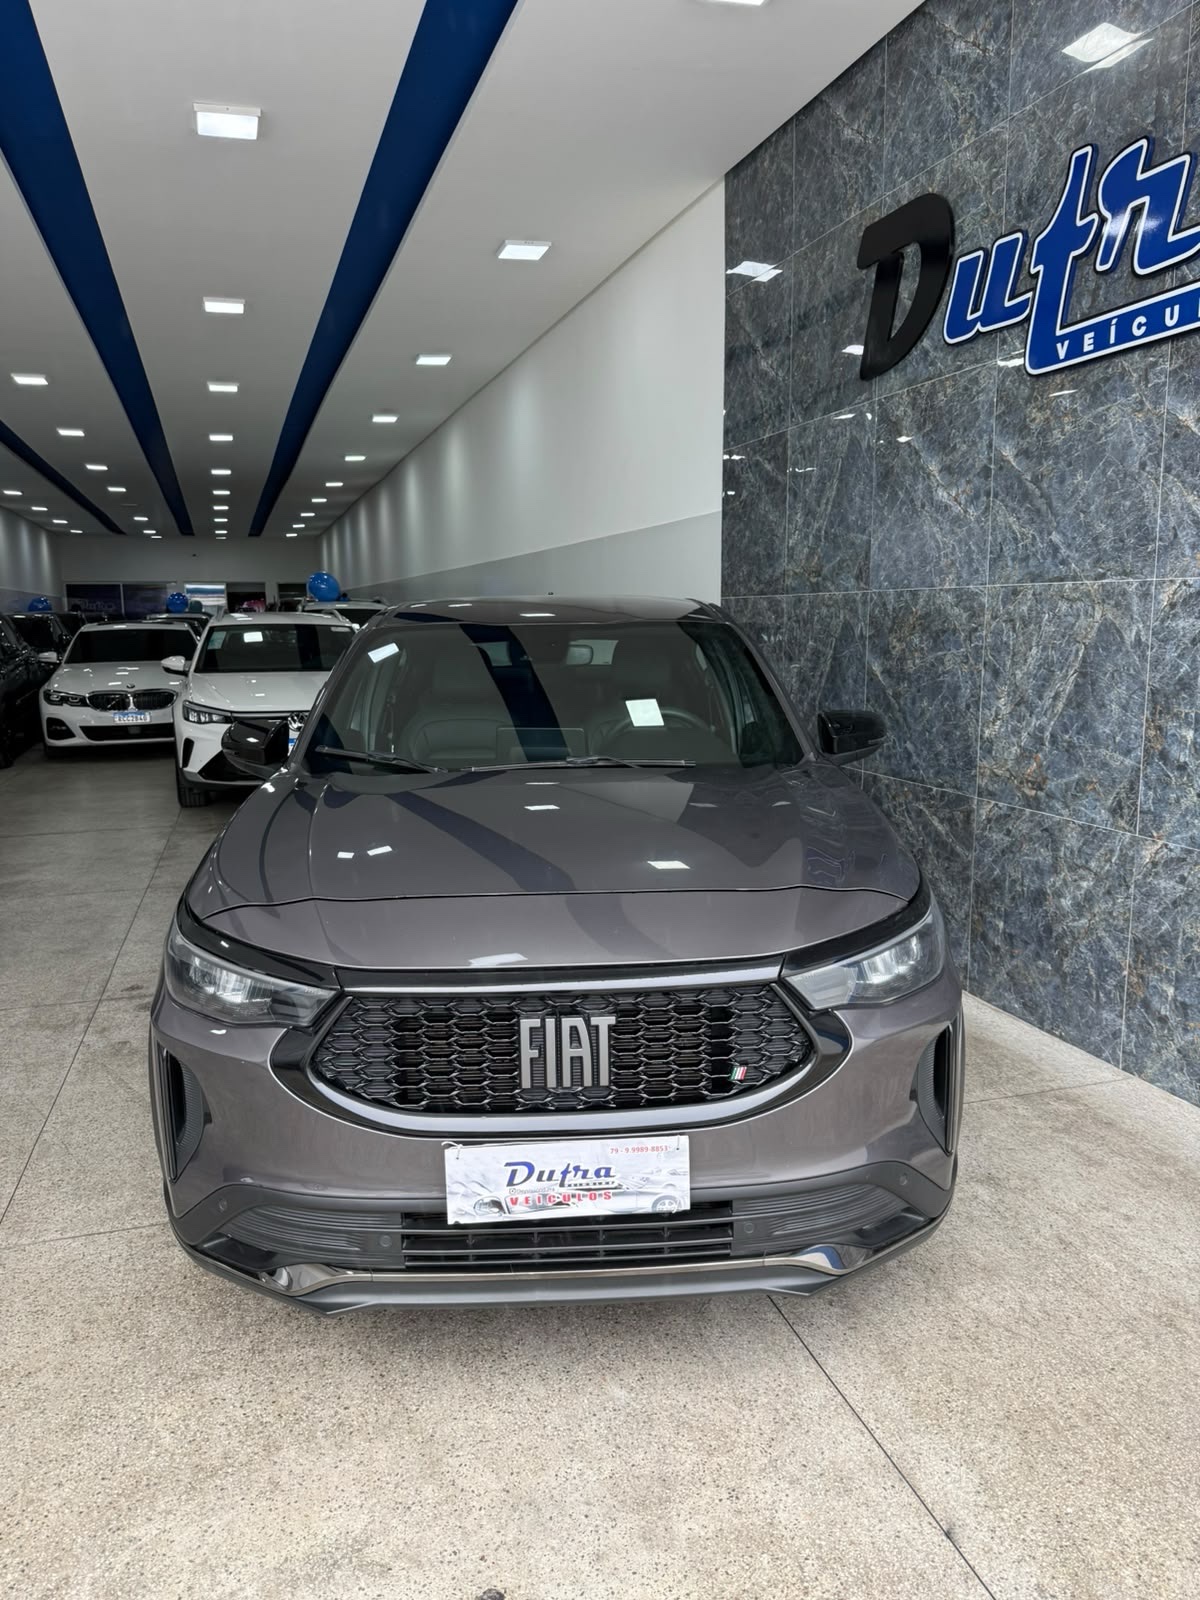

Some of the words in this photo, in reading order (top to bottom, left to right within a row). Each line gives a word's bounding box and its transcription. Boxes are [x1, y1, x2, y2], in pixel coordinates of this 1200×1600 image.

[1056, 297, 1200, 360] VEÍCU
[520, 1016, 616, 1088] FIAT
[503, 1160, 616, 1188] Dutra
[510, 1191, 612, 1206] VEICULOS
